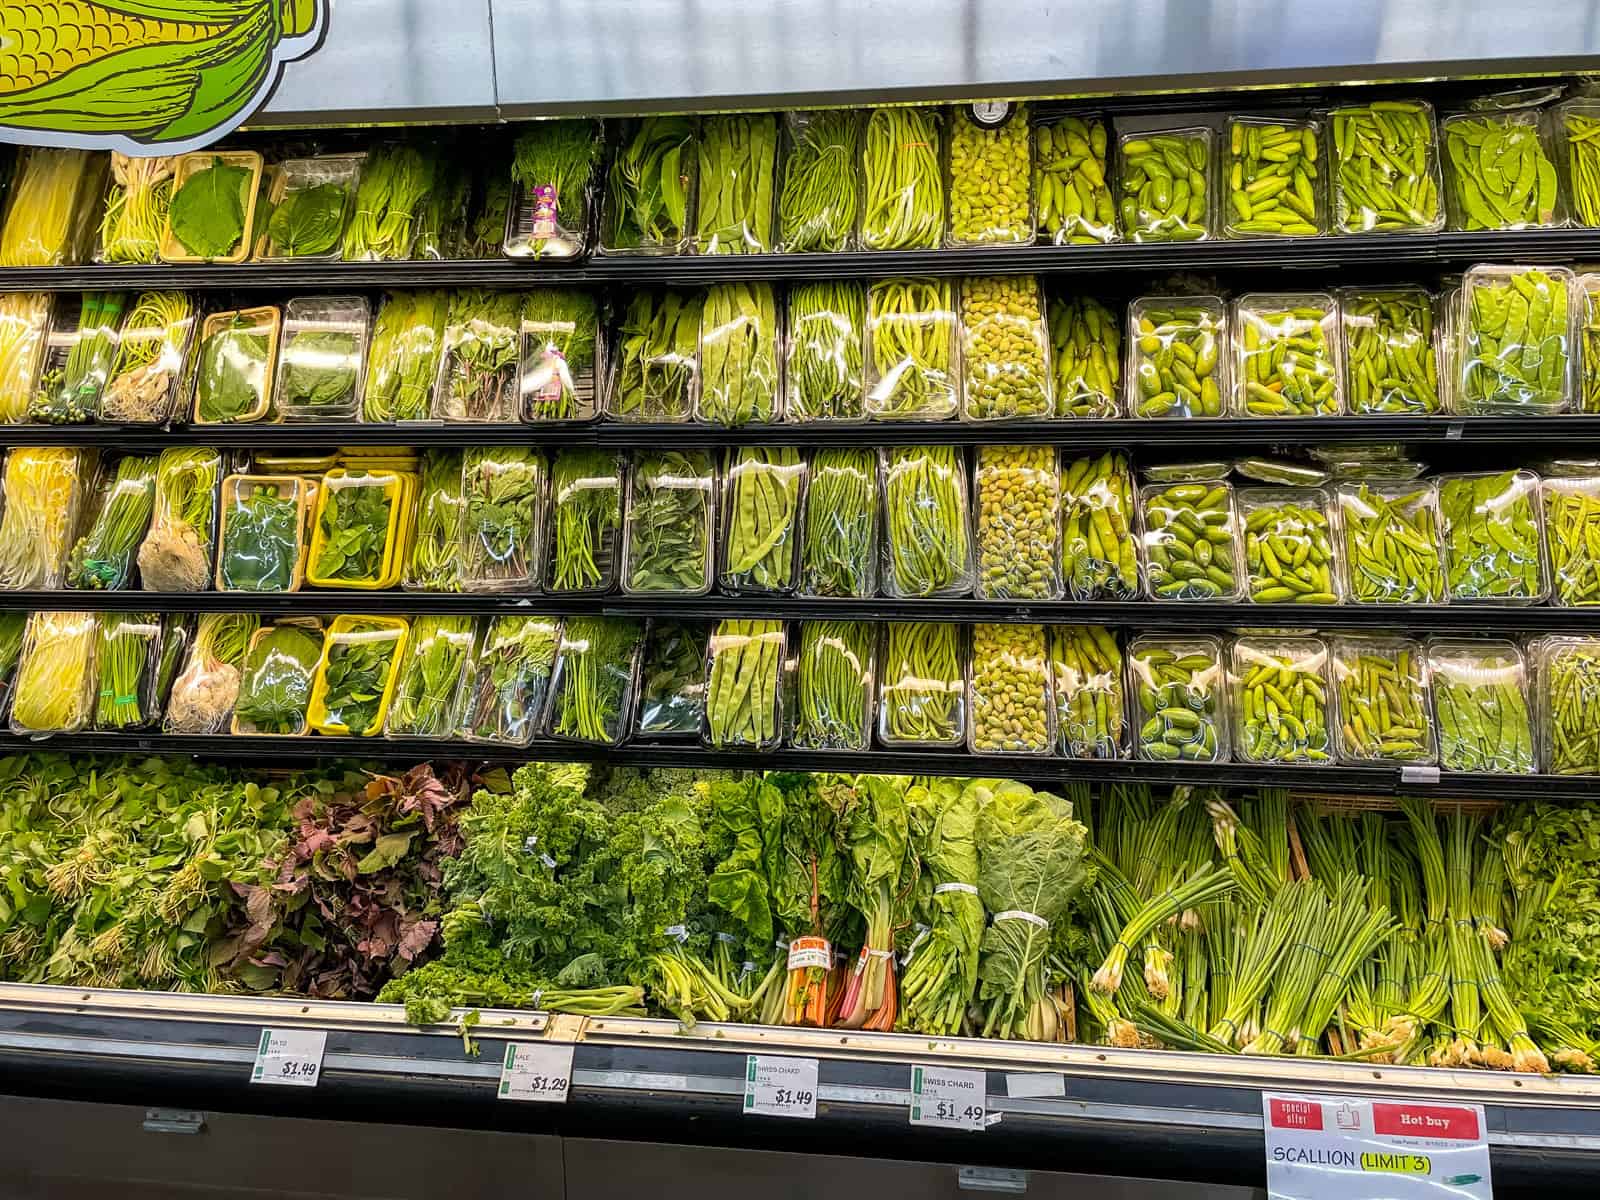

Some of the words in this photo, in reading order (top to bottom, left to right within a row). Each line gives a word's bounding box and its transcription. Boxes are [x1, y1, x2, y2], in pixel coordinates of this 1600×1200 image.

[282, 1061, 316, 1075] $1.49
[532, 1075, 568, 1092] $1.29
[923, 1077, 946, 1087] SWISS
[947, 1080, 974, 1089] CHARD
[775, 1089, 812, 1104] $1.49
[936, 1101, 984, 1121] $1.49
[1400, 1114, 1425, 1126] Hot
[1427, 1115, 1451, 1129] buy
[1273, 1146, 1355, 1167] SCALLION
[1359, 1151, 1409, 1171] (LIMIT
[1412, 1155, 1432, 1176] 3)
